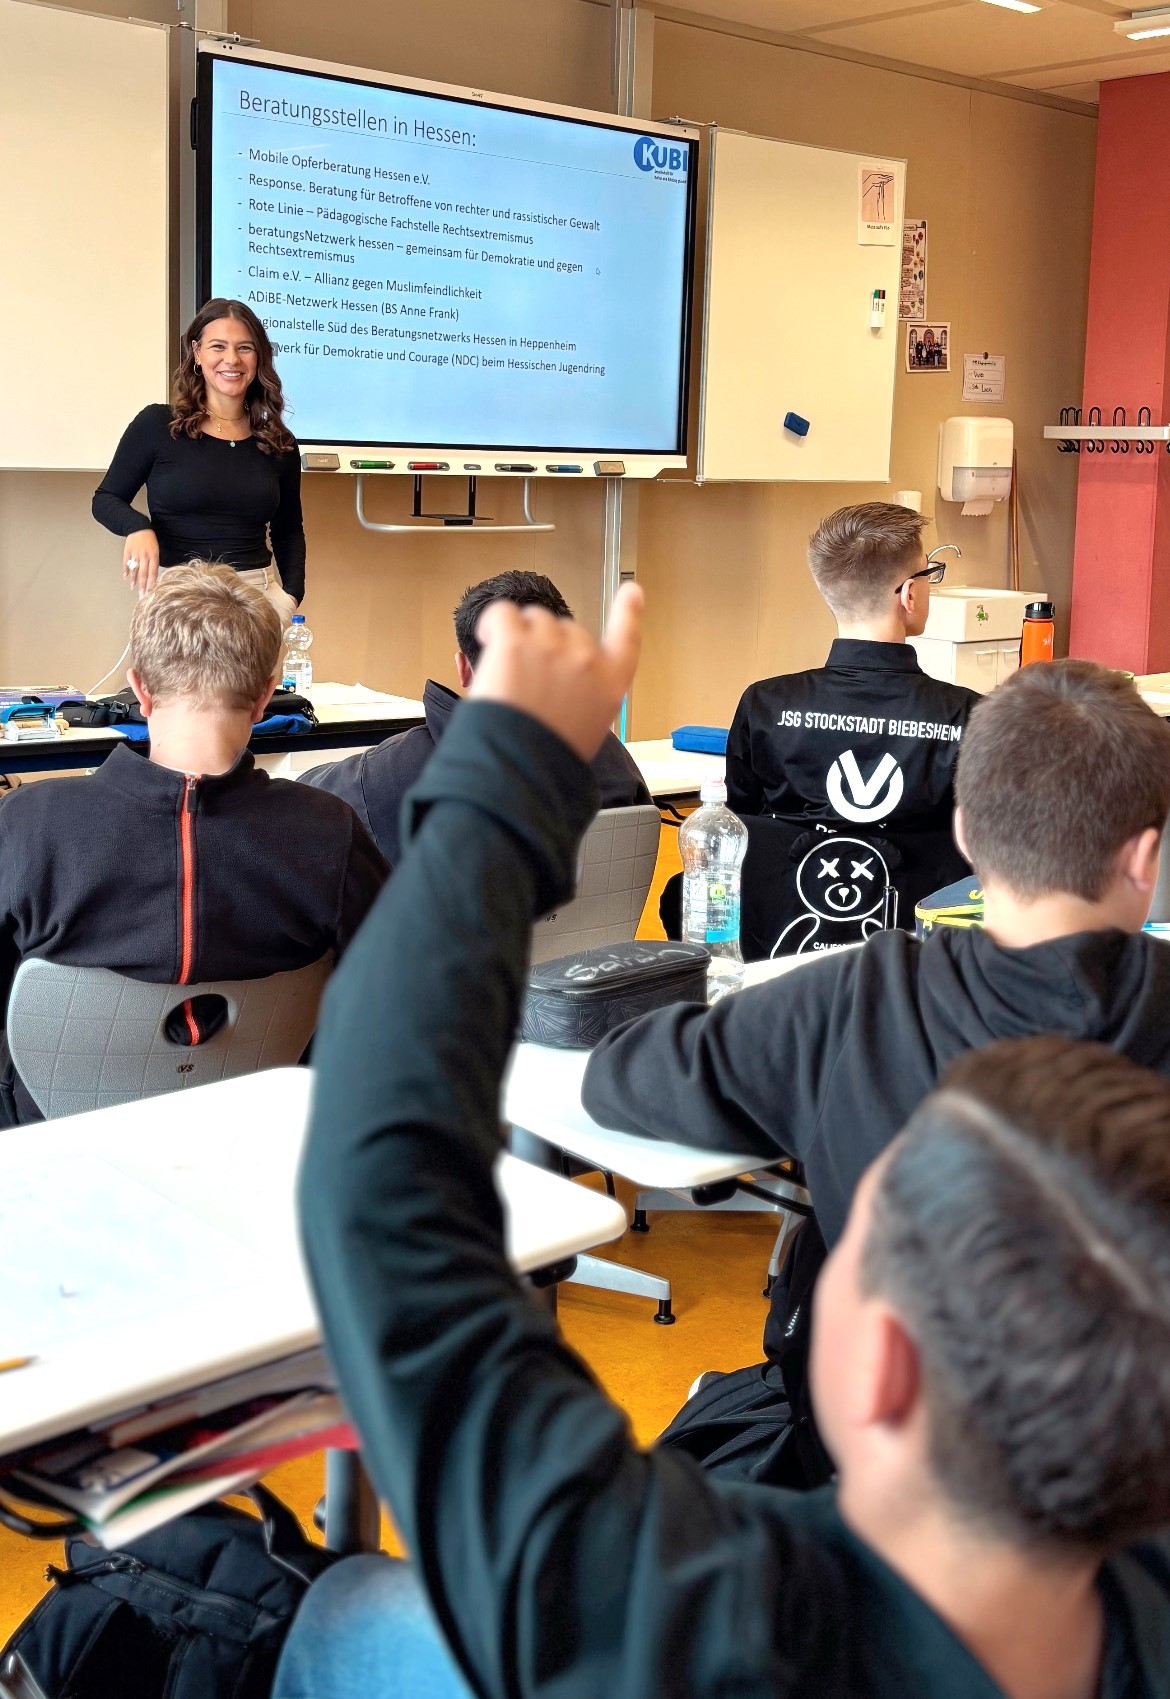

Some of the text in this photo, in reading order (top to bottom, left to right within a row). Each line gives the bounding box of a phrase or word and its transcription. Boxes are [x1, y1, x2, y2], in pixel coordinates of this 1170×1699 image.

[240, 90, 477, 147] Beratungsstellen in Hessen:
[248, 148, 430, 185] Mobile Opferberatung Hessen e.V.
[643, 143, 688, 172] KUBI
[249, 173, 600, 231] Response. Beratung für Betroffene von rechter und rassistischer Gewalt
[249, 198, 274, 212] Rote
[278, 202, 303, 216] Linie
[317, 207, 387, 226] Pädagogische
[391, 217, 439, 233] Fachstelle
[443, 223, 533, 244] Rechtsextremismus
[249, 222, 355, 246] beratungsNetzwerk
[359, 235, 394, 251] hessen
[406, 244, 462, 258] gemeinsam
[464, 248, 479, 260] für
[481, 251, 535, 266] Demokratie
[538, 258, 554, 269] und
[557, 262, 582, 273] gegen
[249, 241, 354, 263] Rechtsextremismus
[248, 266, 279, 279] Claim
[283, 270, 301, 281] e.V.
[314, 272, 349, 286] Allianz
[352, 279, 383, 291] gegen
[387, 280, 482, 299] Muslimfeindlichkeit
[247, 291, 459, 322] ADiBE-Netzwerk Hessen (BS Anne Frank)
[261, 317, 576, 352] gionalstelle Süd des Beratungsnetzwerks Hessen in Heppenheim
[304, 343, 320, 355] für
[323, 345, 383, 359] Demokratie
[387, 350, 405, 361] und
[409, 352, 448, 366] Courage
[452, 353, 479, 368] (NDC)
[482, 355, 504, 367] beim
[508, 358, 556, 371] Hessischen
[558, 362, 606, 376] Jugendring
[777, 710, 962, 742] JSG STOCKSTADT BIEBESHEIM
